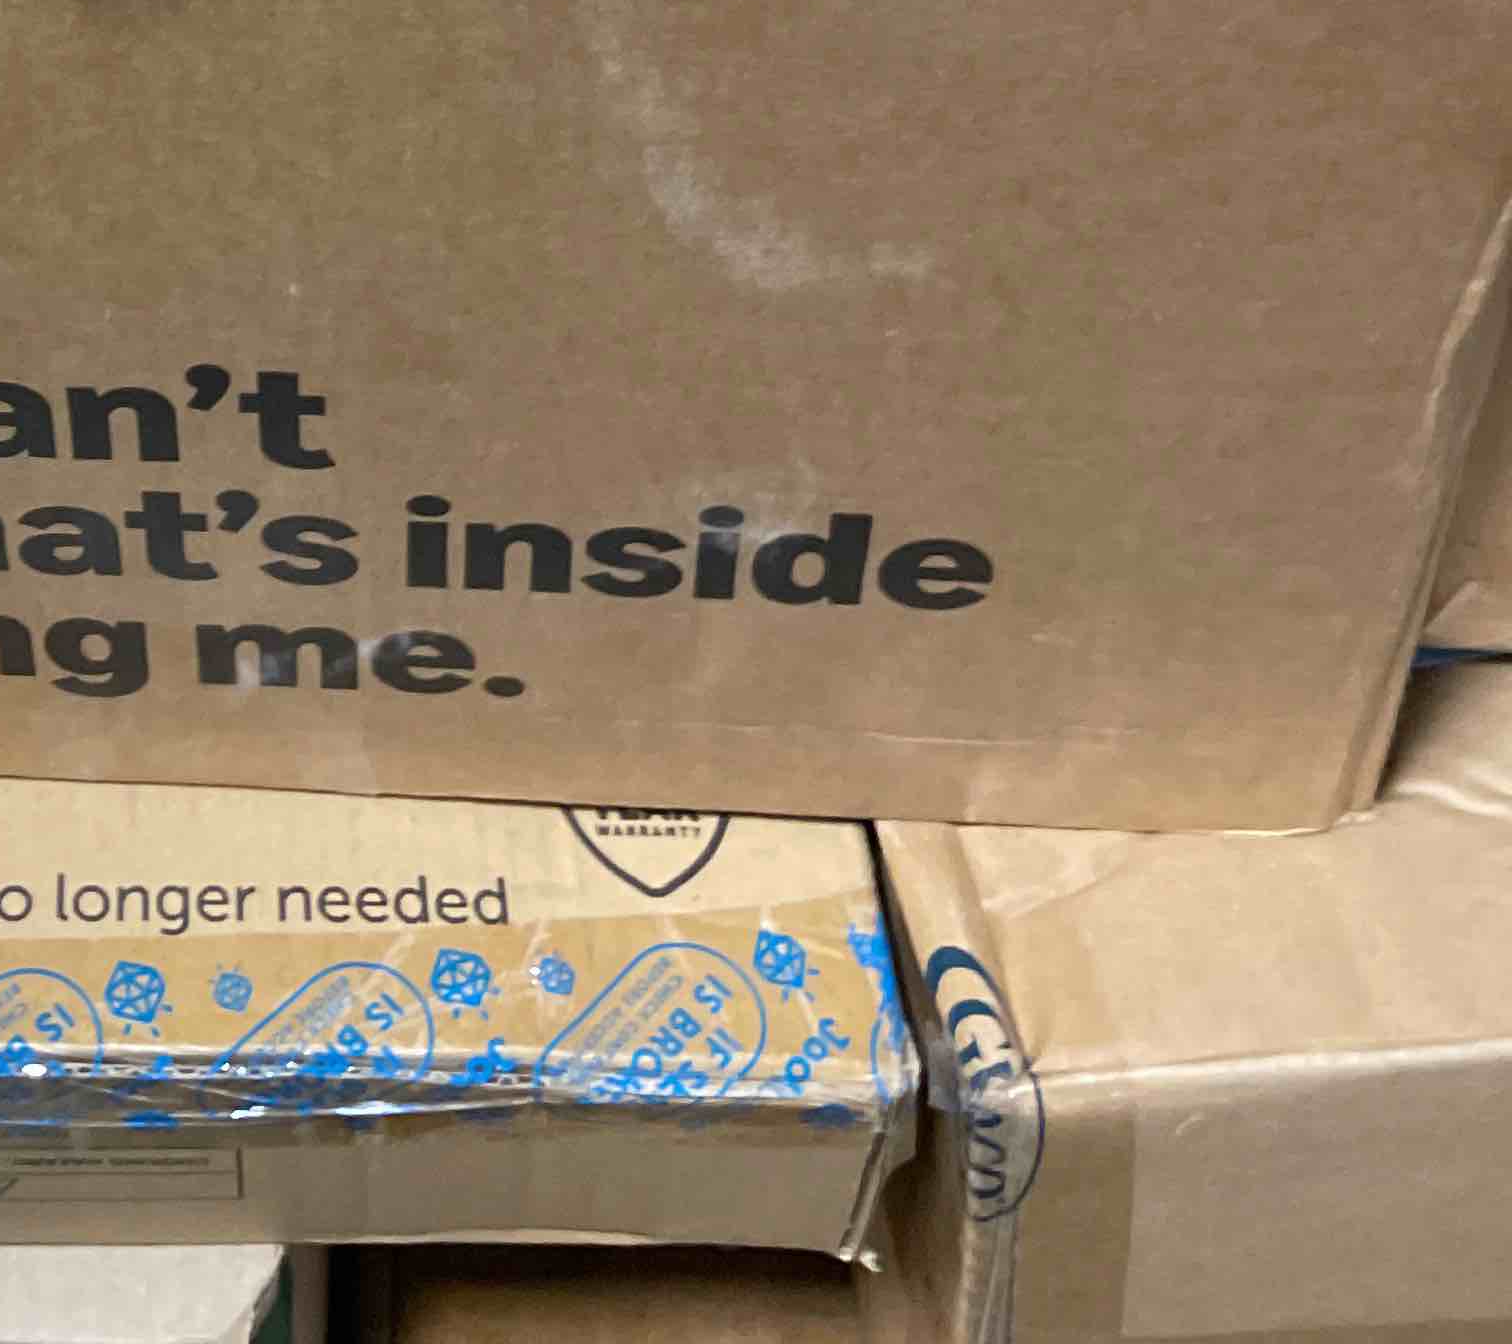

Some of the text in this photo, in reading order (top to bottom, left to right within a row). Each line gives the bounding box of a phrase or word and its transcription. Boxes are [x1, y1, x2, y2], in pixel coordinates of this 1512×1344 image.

[404, 492, 995, 612] inside
[195, 621, 526, 700] me.
[55, 872, 256, 936] longer
[276, 874, 511, 927] needed
